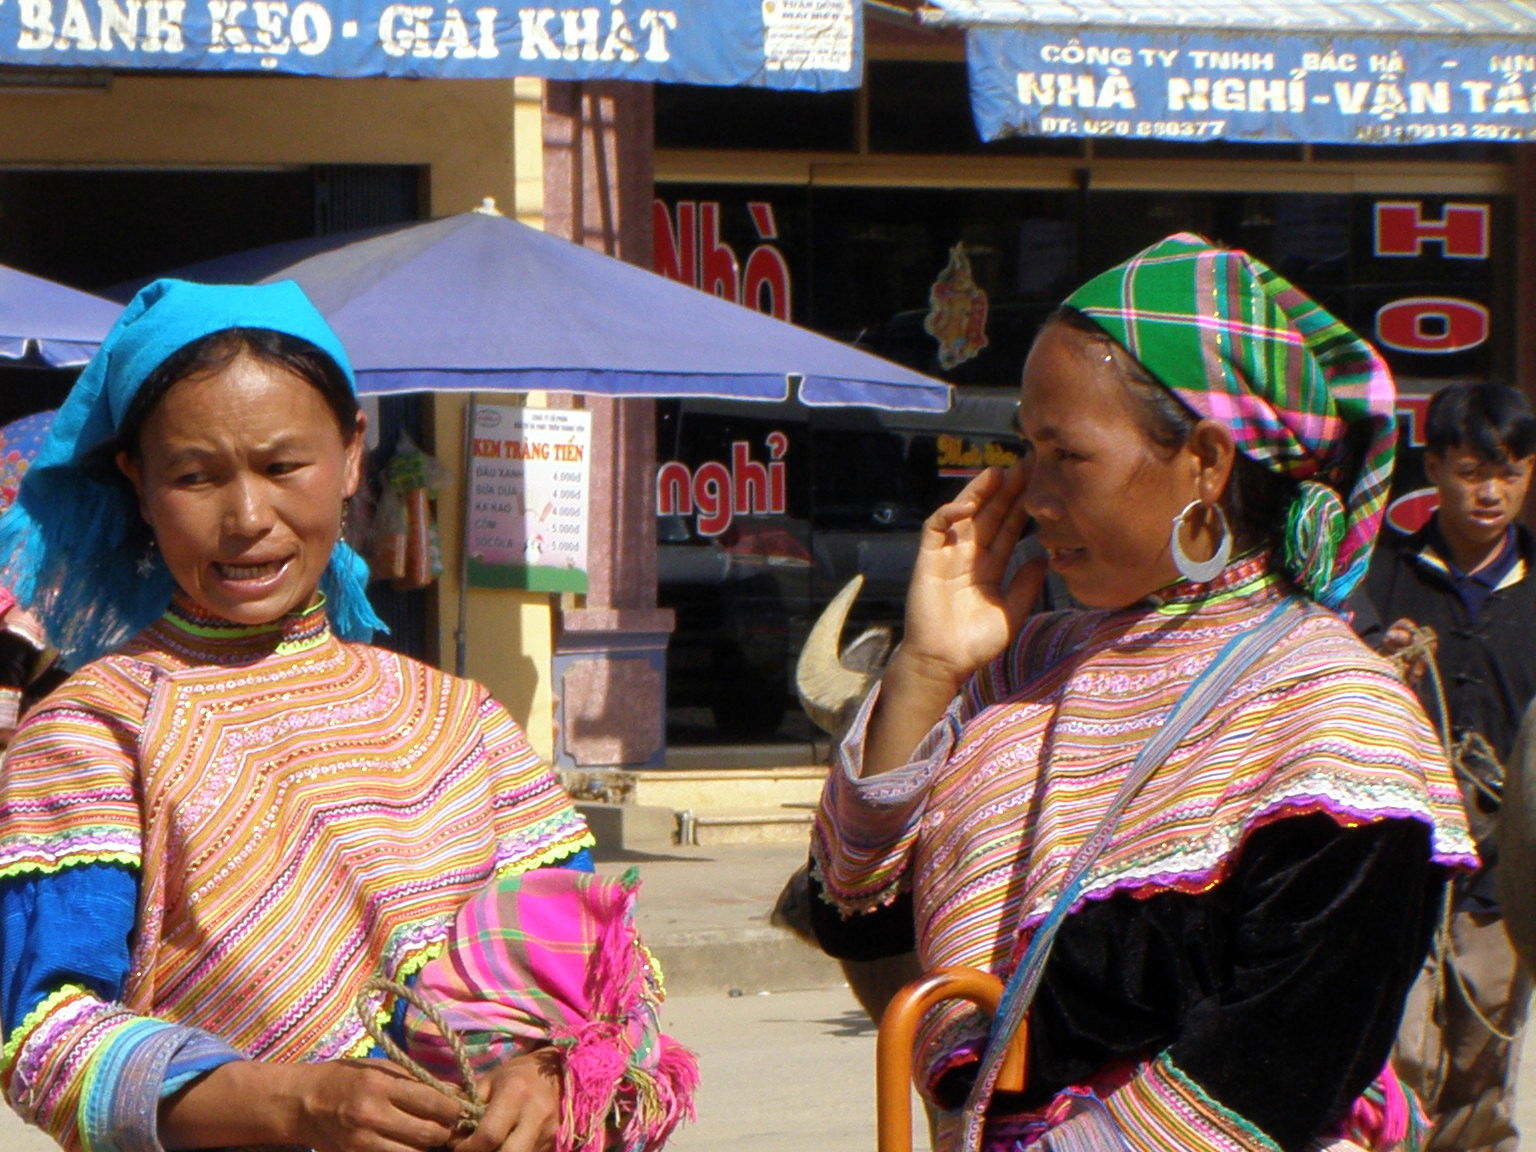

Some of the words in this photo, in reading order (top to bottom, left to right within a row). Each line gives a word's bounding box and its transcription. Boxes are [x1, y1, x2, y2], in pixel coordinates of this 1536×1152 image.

[208, 0, 332, 69] KẸO
[1040, 39, 1132, 65] CÔNG
[1138, 49, 1180, 67] TY
[1188, 51, 1275, 71] TNHH
[1016, 68, 1135, 108] NHÀ
[1460, 71, 1536, 114] TẢ
[473, 438, 501, 459] KEM
[656, 431, 788, 537] nghỉ
